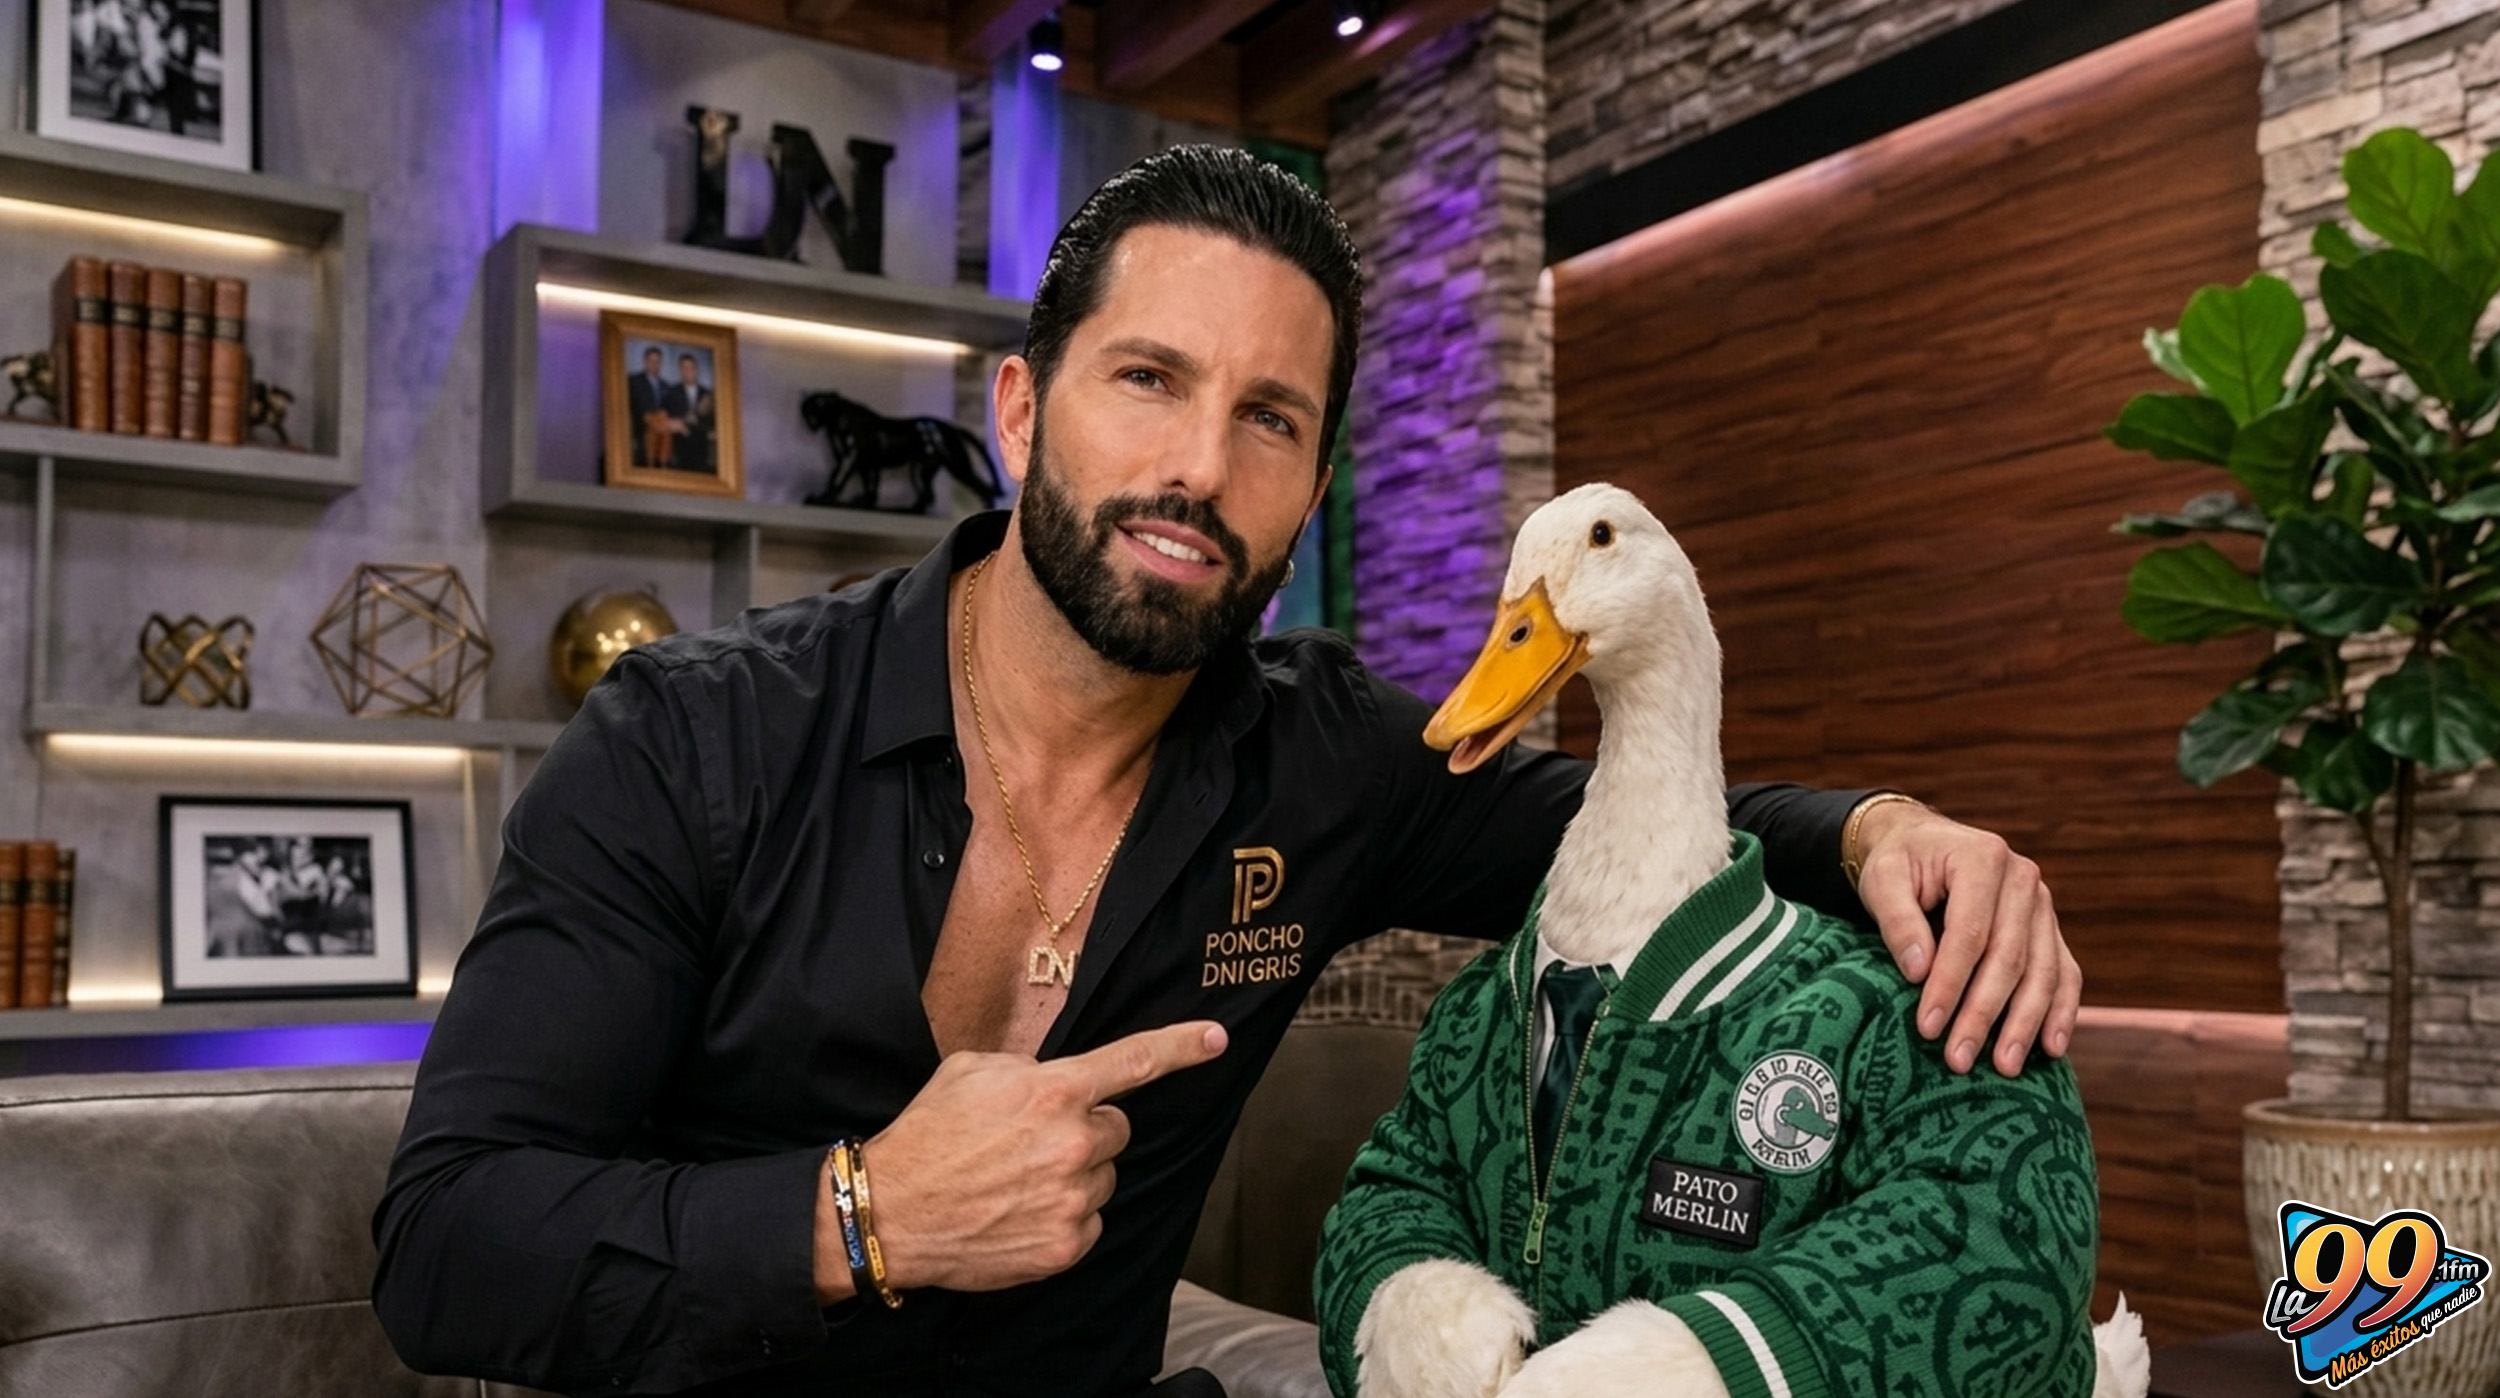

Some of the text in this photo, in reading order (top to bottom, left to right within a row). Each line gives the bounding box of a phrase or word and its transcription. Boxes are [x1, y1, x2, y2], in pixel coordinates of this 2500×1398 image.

[1206, 924, 1304, 957] PONCHO
[1673, 1171, 1738, 1204] PATO
[1652, 1192, 1749, 1234] MERLIN
